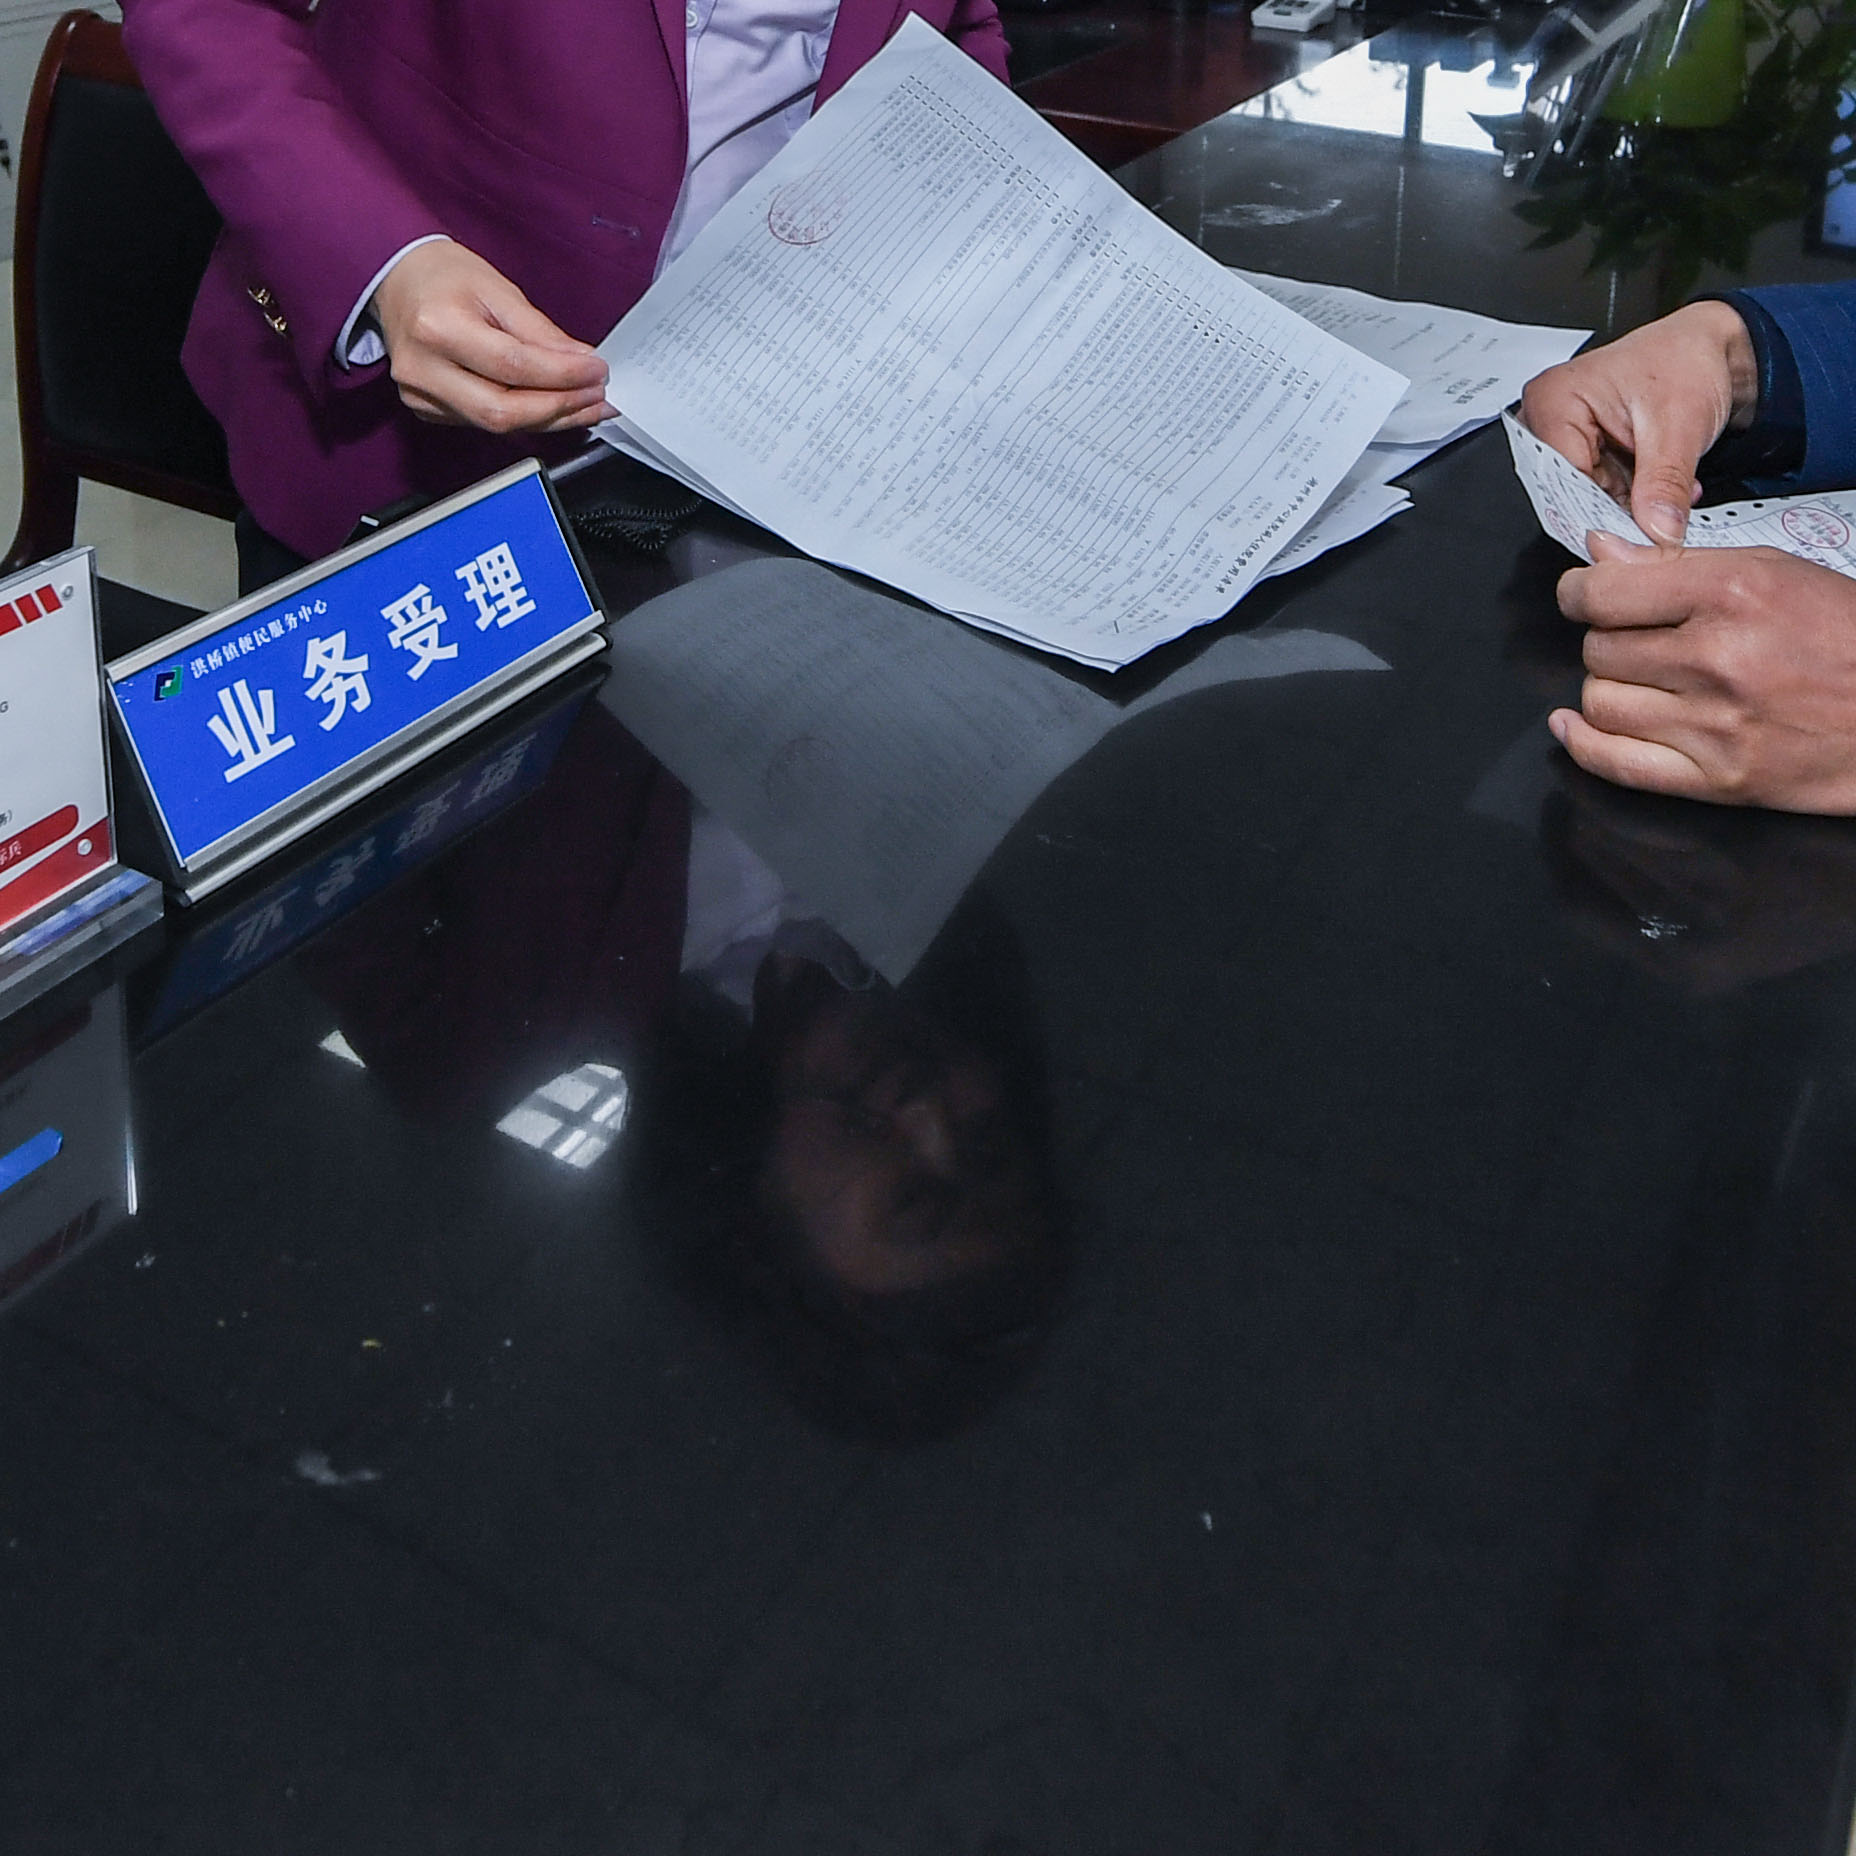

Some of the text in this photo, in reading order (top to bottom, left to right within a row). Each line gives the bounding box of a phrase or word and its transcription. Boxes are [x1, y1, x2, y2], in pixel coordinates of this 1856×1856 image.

[189, 597, 329, 680] 洪桥镇便民服务中心
[206, 541, 537, 784] 业务受理
